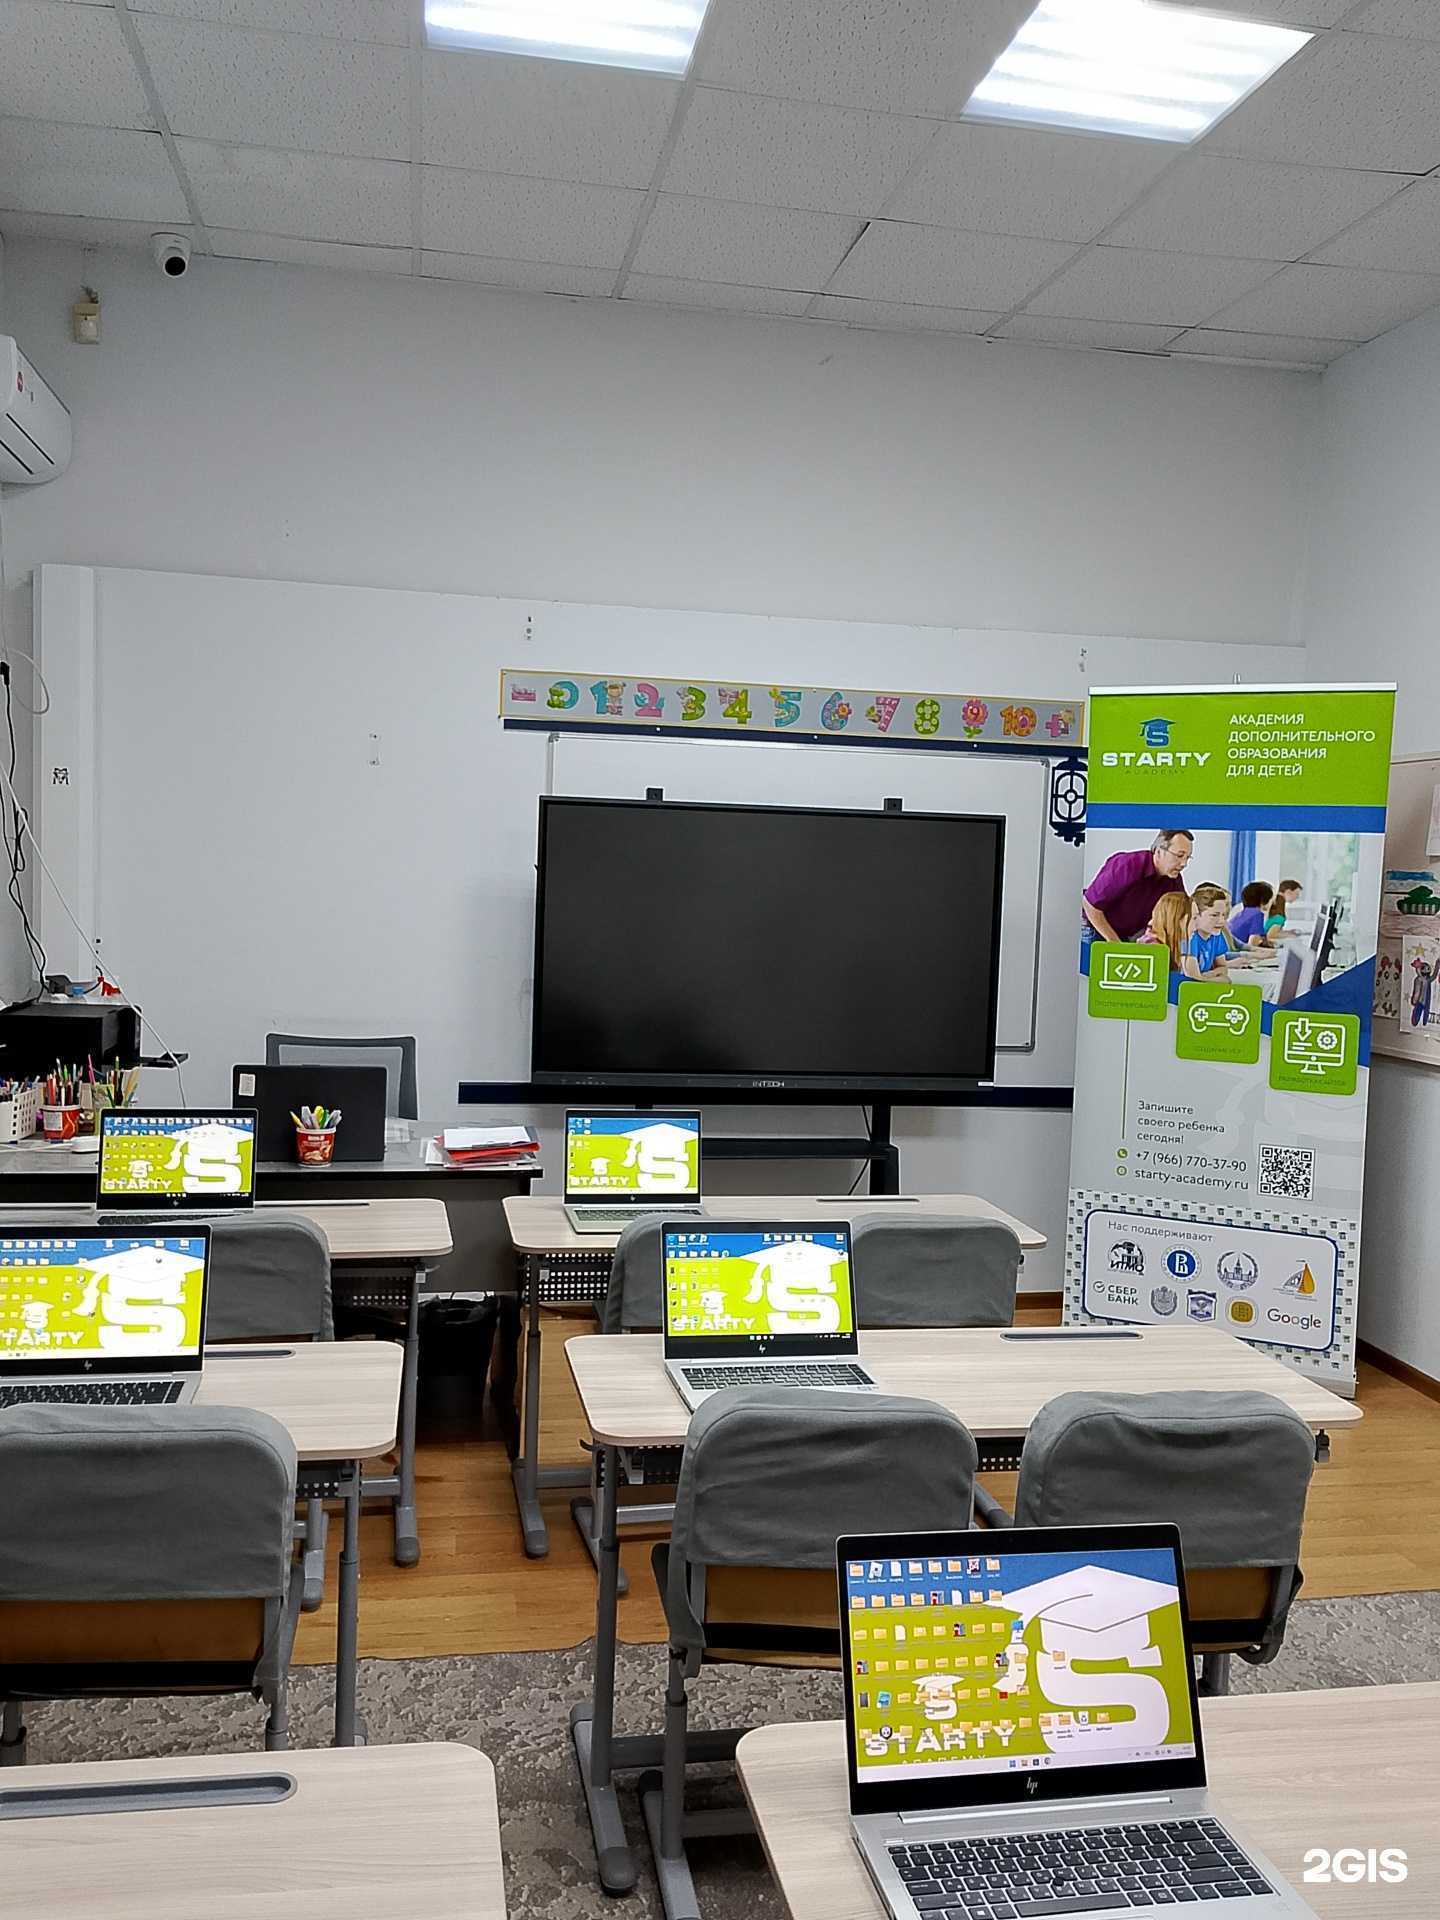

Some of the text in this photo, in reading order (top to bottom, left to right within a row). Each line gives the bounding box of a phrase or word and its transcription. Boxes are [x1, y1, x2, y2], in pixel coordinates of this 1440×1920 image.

[914, 698, 941, 735] 8
[1000, 704, 1038, 737] 10
[1229, 713, 1304, 727] АКАДЕМИЯ
[1228, 730, 1376, 744] ДОПОЛНИТЕЛЬНОГО
[1102, 752, 1211, 767] STARTY
[1227, 747, 1327, 760] ОБРАЗОВАНИЯ
[1226, 763, 1303, 778] ДЛЯ ДЕТЕЙ
[1138, 1100, 1194, 1115] Запишите
[1137, 1117, 1225, 1133] своего ребенка
[1136, 1132, 1185, 1145] сегодня!
[1136, 1151, 1248, 1172] +7 (966) 770-37-90
[1108, 1221, 1213, 1242] Нас поддерживают
[1110, 1259, 1145, 1273] ИТМО
[1107, 1284, 1138, 1296] СБЕР
[1107, 1293, 1140, 1306] БАНК
[1267, 1308, 1322, 1330] Google
